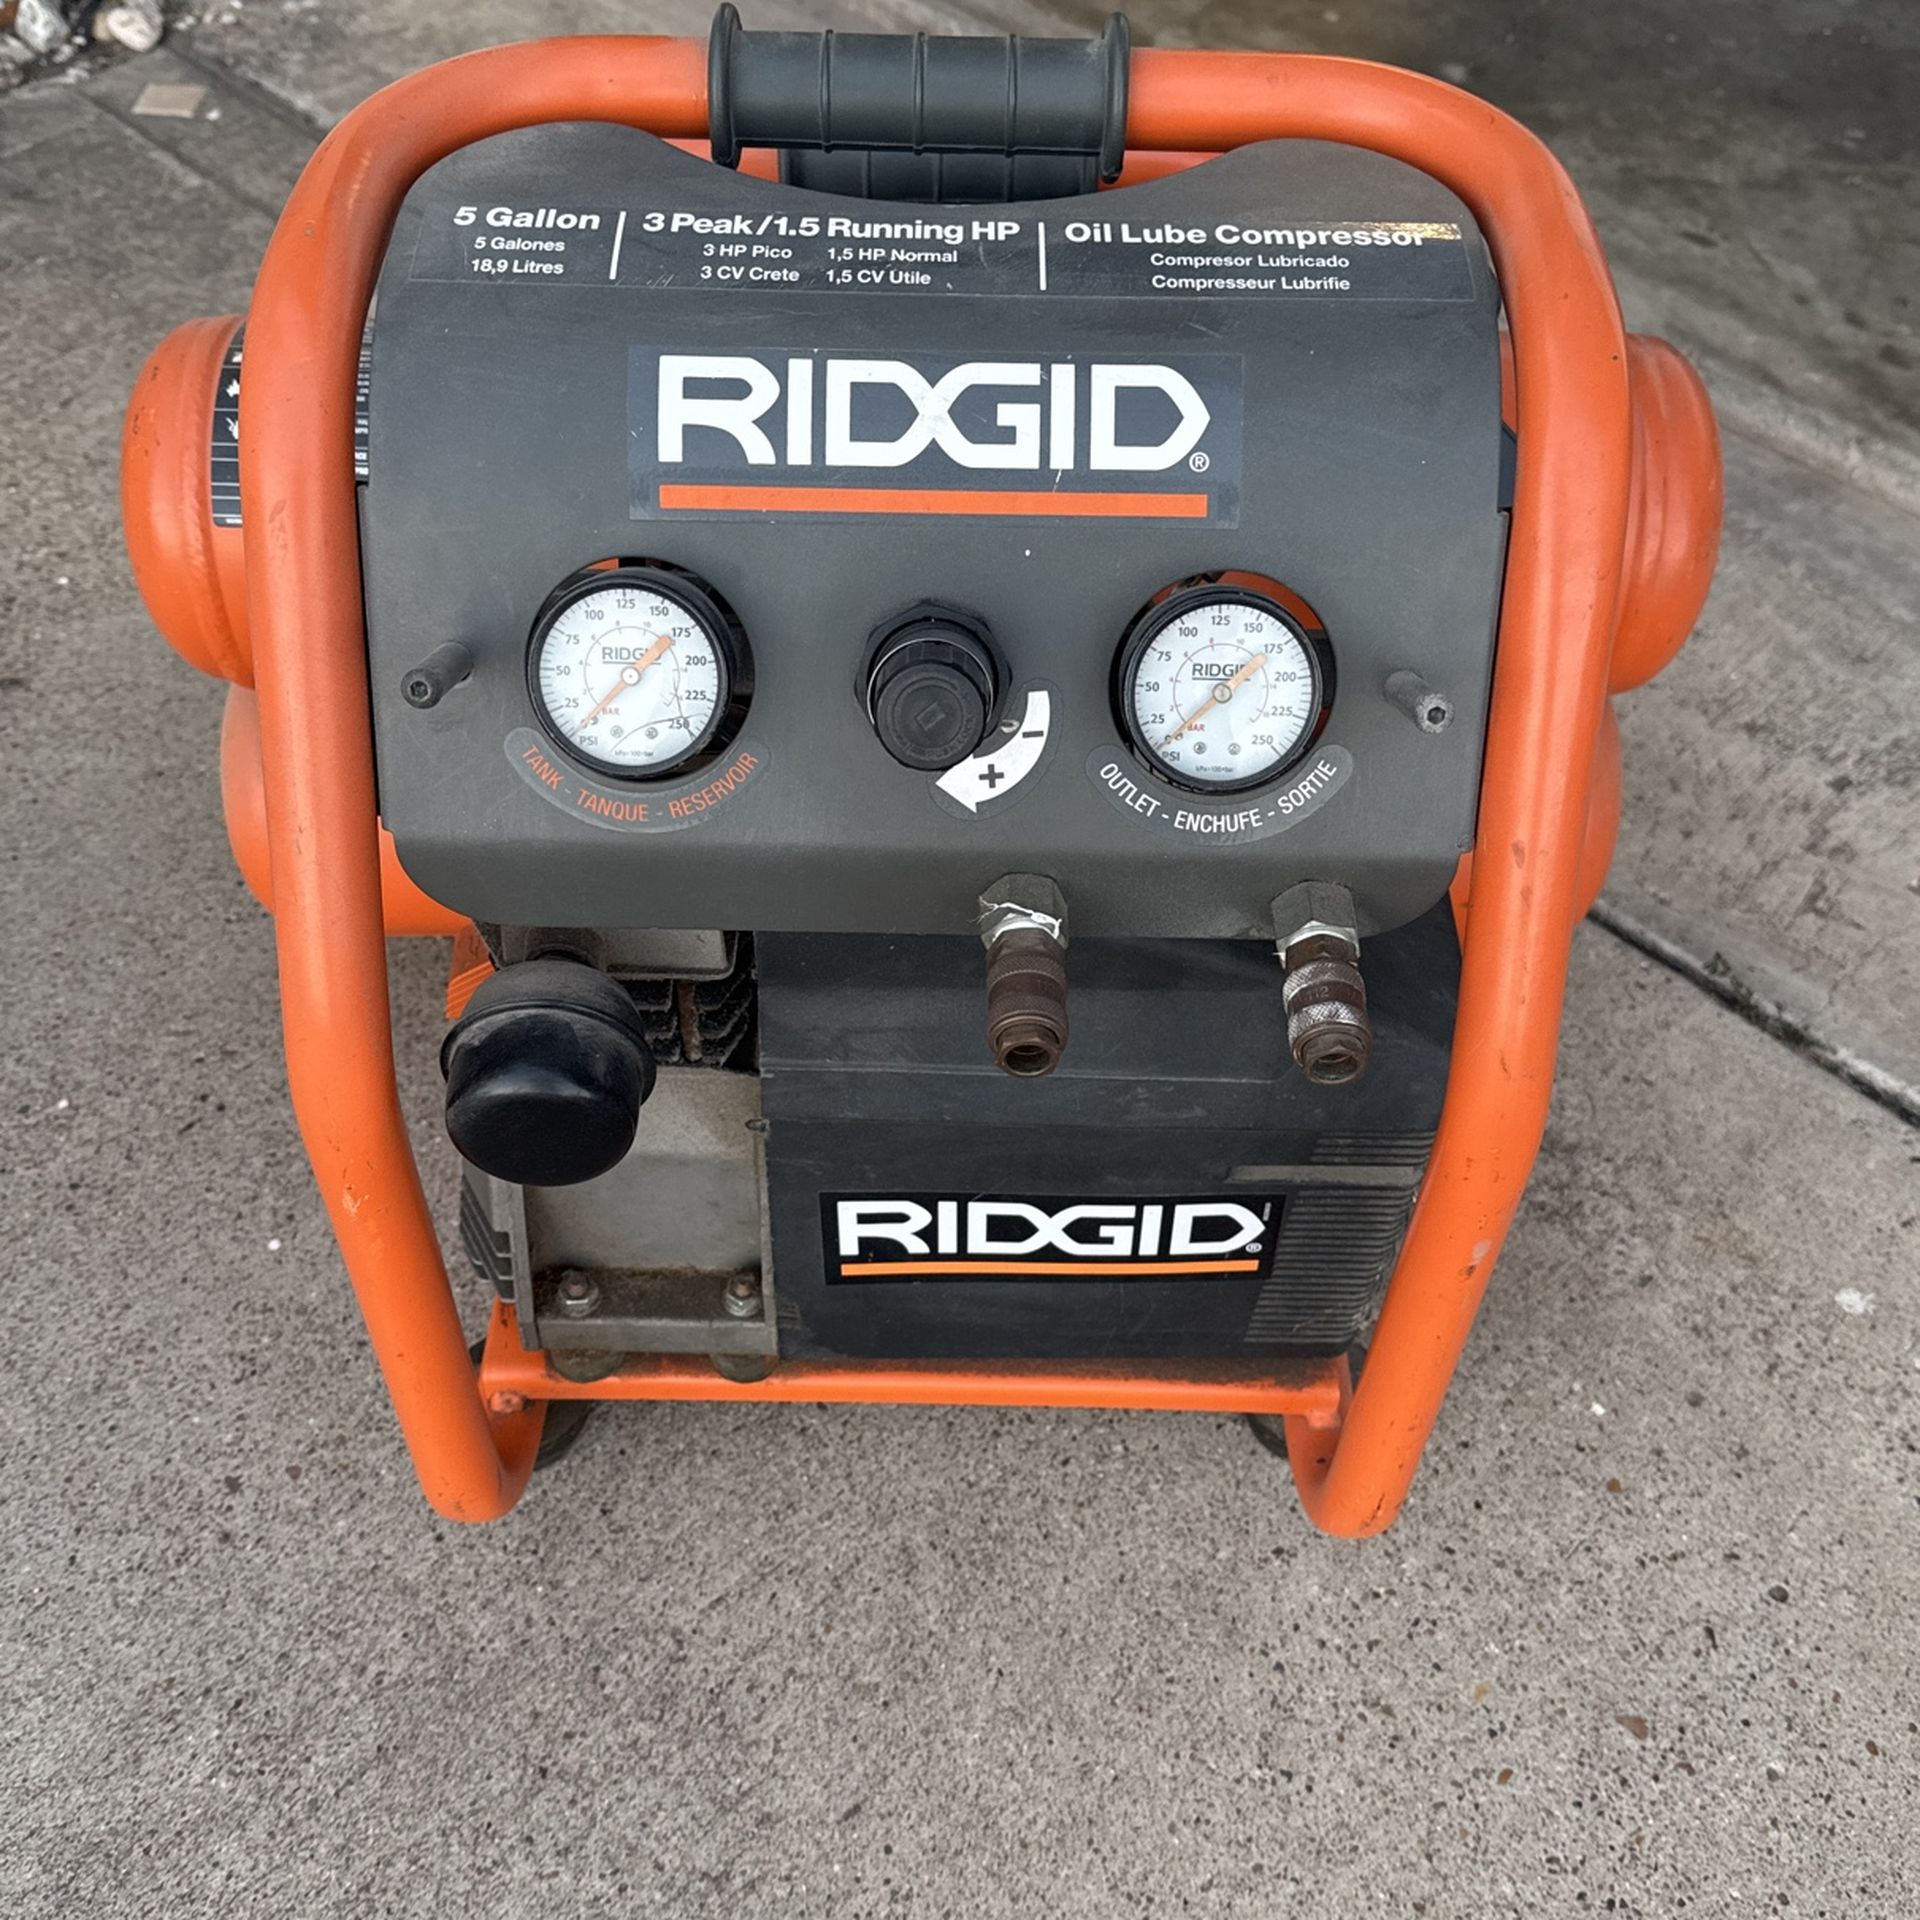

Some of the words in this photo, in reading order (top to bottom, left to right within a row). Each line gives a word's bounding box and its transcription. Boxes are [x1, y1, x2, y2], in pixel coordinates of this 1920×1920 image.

[453, 206, 478, 226] 5
[486, 206, 601, 230] Gallon
[642, 212, 665, 232] 3
[827, 217, 964, 245] Running
[971, 221, 1020, 241] HP
[1064, 222, 1112, 244] Oil
[1121, 223, 1207, 245] Lube
[1214, 223, 1426, 249] Compressor
[474, 236, 487, 249] 5
[490, 236, 566, 251] Galones
[703, 243, 716, 257] 3
[719, 244, 748, 258] HP
[752, 245, 793, 259] Pico
[827, 247, 854, 262] 1,5
[858, 248, 886, 262] HP
[890, 249, 958, 264] Normal
[471, 258, 509, 275] 18,9
[512, 259, 565, 275] Litres
[1150, 252, 1253, 269] Compresor
[1257, 254, 1350, 270] Lubricado
[700, 265, 713, 279] 3
[716, 266, 745, 280] CV
[749, 266, 801, 282] Crete
[826, 269, 853, 285] 1,5
[857, 270, 885, 284] CV
[889, 270, 932, 285] Utile
[1151, 275, 1277, 291] Compresseur
[1281, 275, 1351, 291] Lubrifie
[657, 354, 1212, 471] RIDGID
[616, 599, 635, 609] 125
[585, 610, 604, 620] 100
[650, 606, 669, 617] 150
[1211, 615, 1231, 626] 125
[672, 627, 692, 638] 175
[1178, 627, 1198, 637] 100
[1243, 622, 1263, 633] 150
[566, 635, 580, 645] 75
[602, 647, 661, 661] RIDG
[1264, 643, 1283, 654] 175
[685, 656, 707, 667] 200
[1157, 651, 1172, 662] 75
[556, 666, 570, 676] 50
[1275, 671, 1296, 682] 200
[1145, 682, 1160, 692] 50
[685, 690, 707, 701] 225
[565, 698, 579, 708] 25
[1271, 706, 1293, 717] 225
[668, 719, 690, 730] 250
[1151, 714, 1165, 724] 25
[579, 735, 598, 746] PSI
[1251, 735, 1274, 746] 250
[522, 744, 565, 791] TANK
[576, 788, 648, 822] TANQUE
[668, 752, 759, 819] RESERVOIR
[1100, 763, 1161, 818] OUTLET
[1173, 808, 1263, 833] ENCHUFE
[1277, 758, 1337, 814] SORTIE
[837, 1200, 1266, 1256] RIDGID
